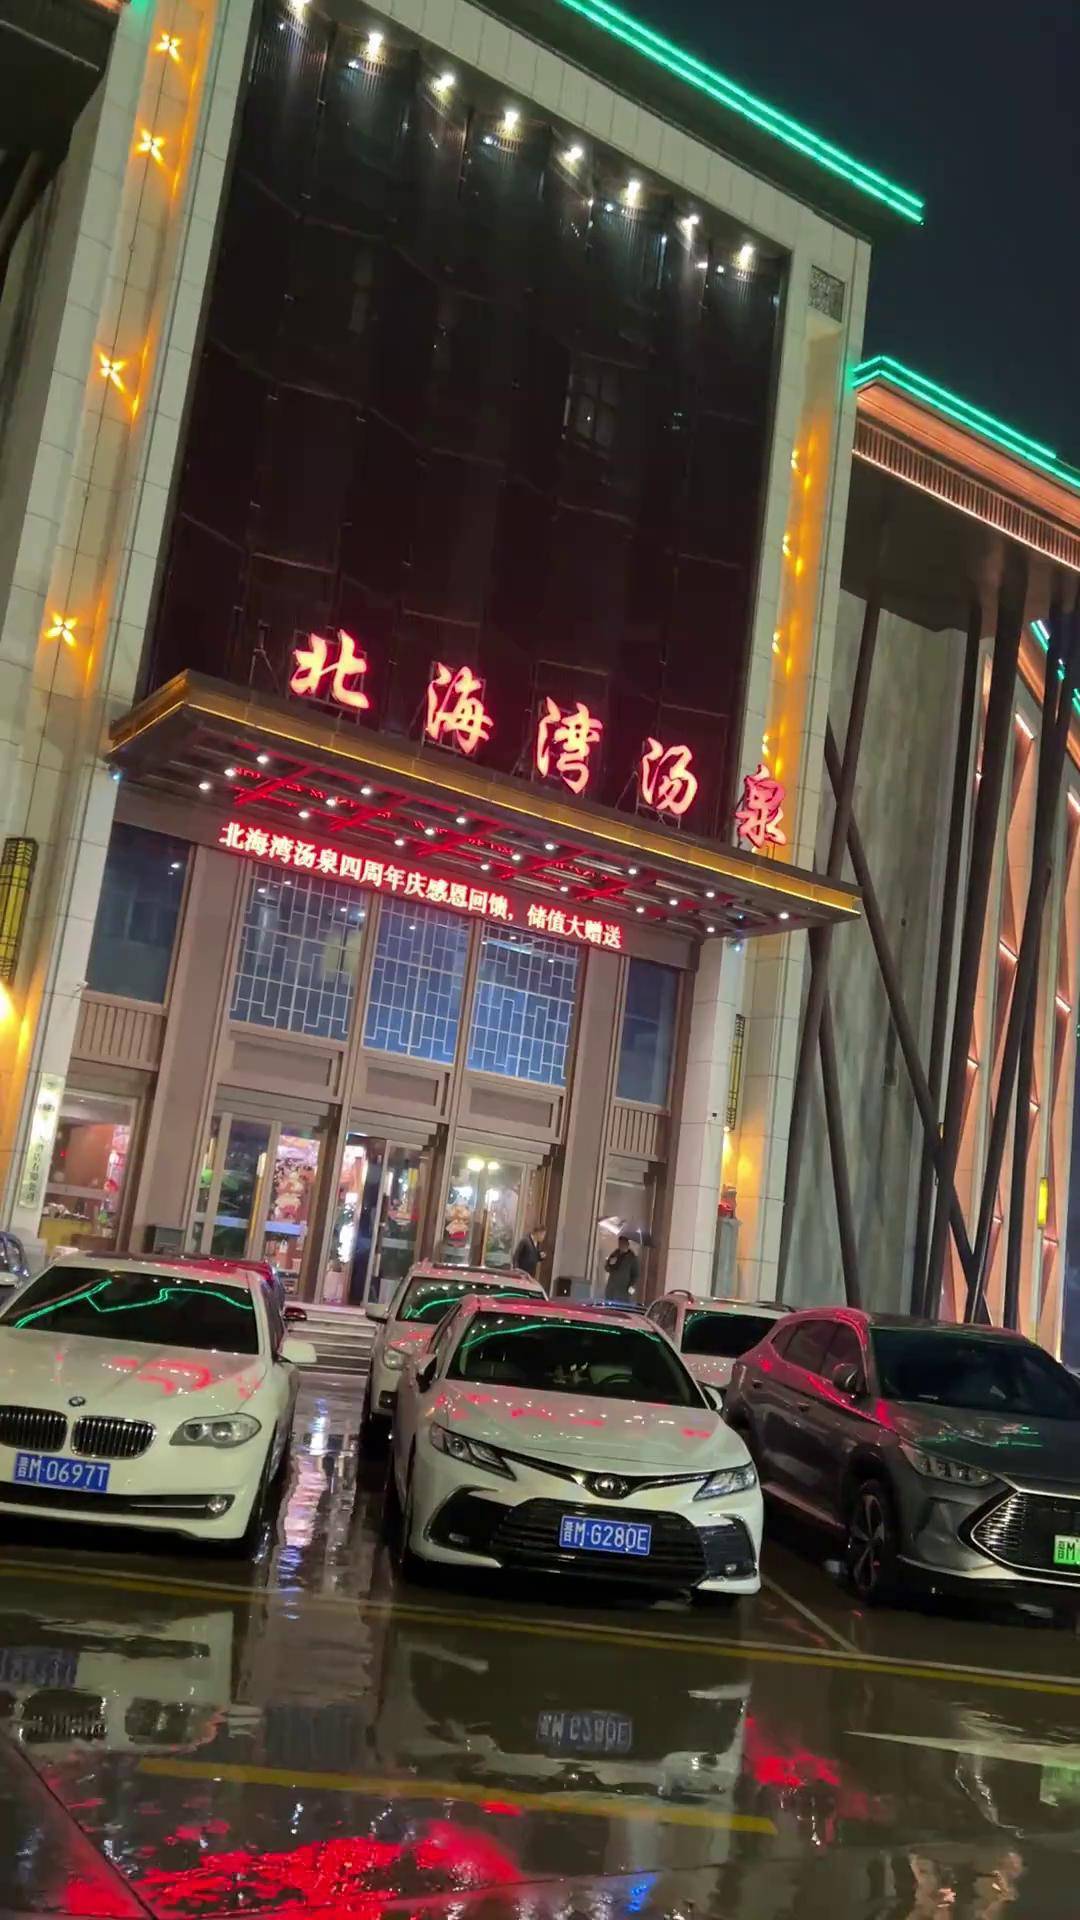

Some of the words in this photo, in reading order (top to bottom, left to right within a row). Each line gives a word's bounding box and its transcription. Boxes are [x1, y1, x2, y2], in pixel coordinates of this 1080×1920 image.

[291, 629, 787, 848] 北海湾汤泉
